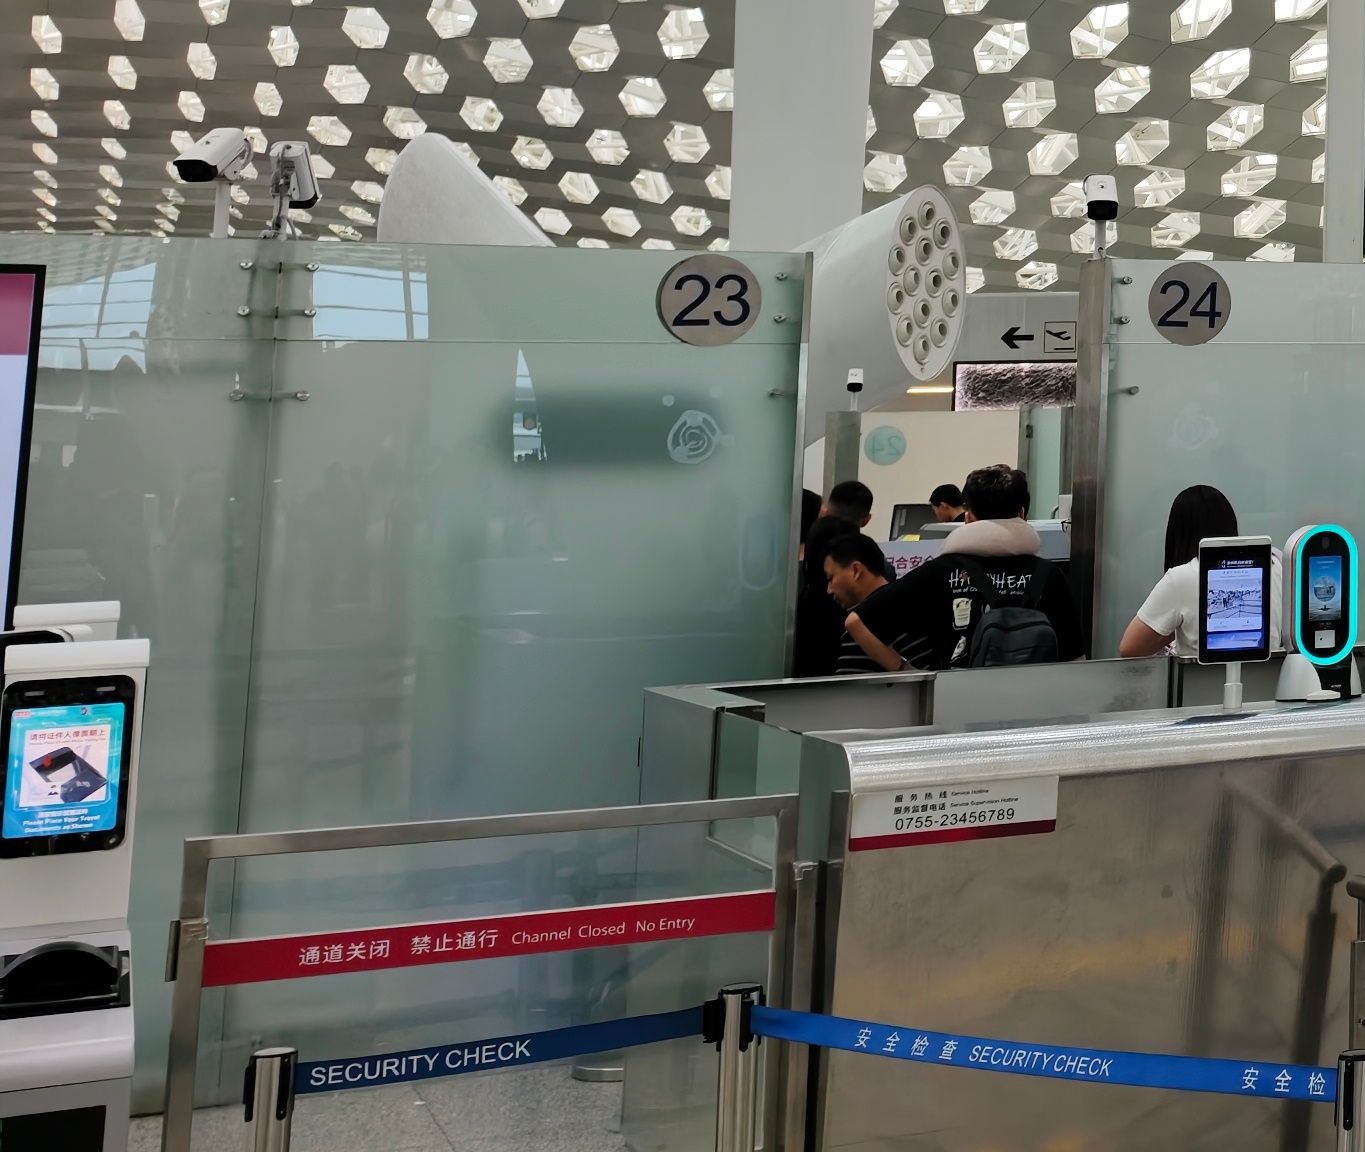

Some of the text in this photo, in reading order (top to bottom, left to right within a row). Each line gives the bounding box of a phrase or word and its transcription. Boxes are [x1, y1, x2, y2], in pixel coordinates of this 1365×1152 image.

[671, 274, 751, 328] 23
[1157, 281, 1222, 328] 24
[893, 803, 946, 815] 服务监督电话
[894, 791, 948, 803] 服务热线
[895, 807, 1015, 831] 0755-23456789
[298, 916, 696, 967] 通道关闭 禁止通行 Channel Closed No Entry
[310, 1039, 533, 1087] SECURITY CHECK
[853, 1027, 1326, 1097] 安全检查 SECURITY CHECK 安全检
